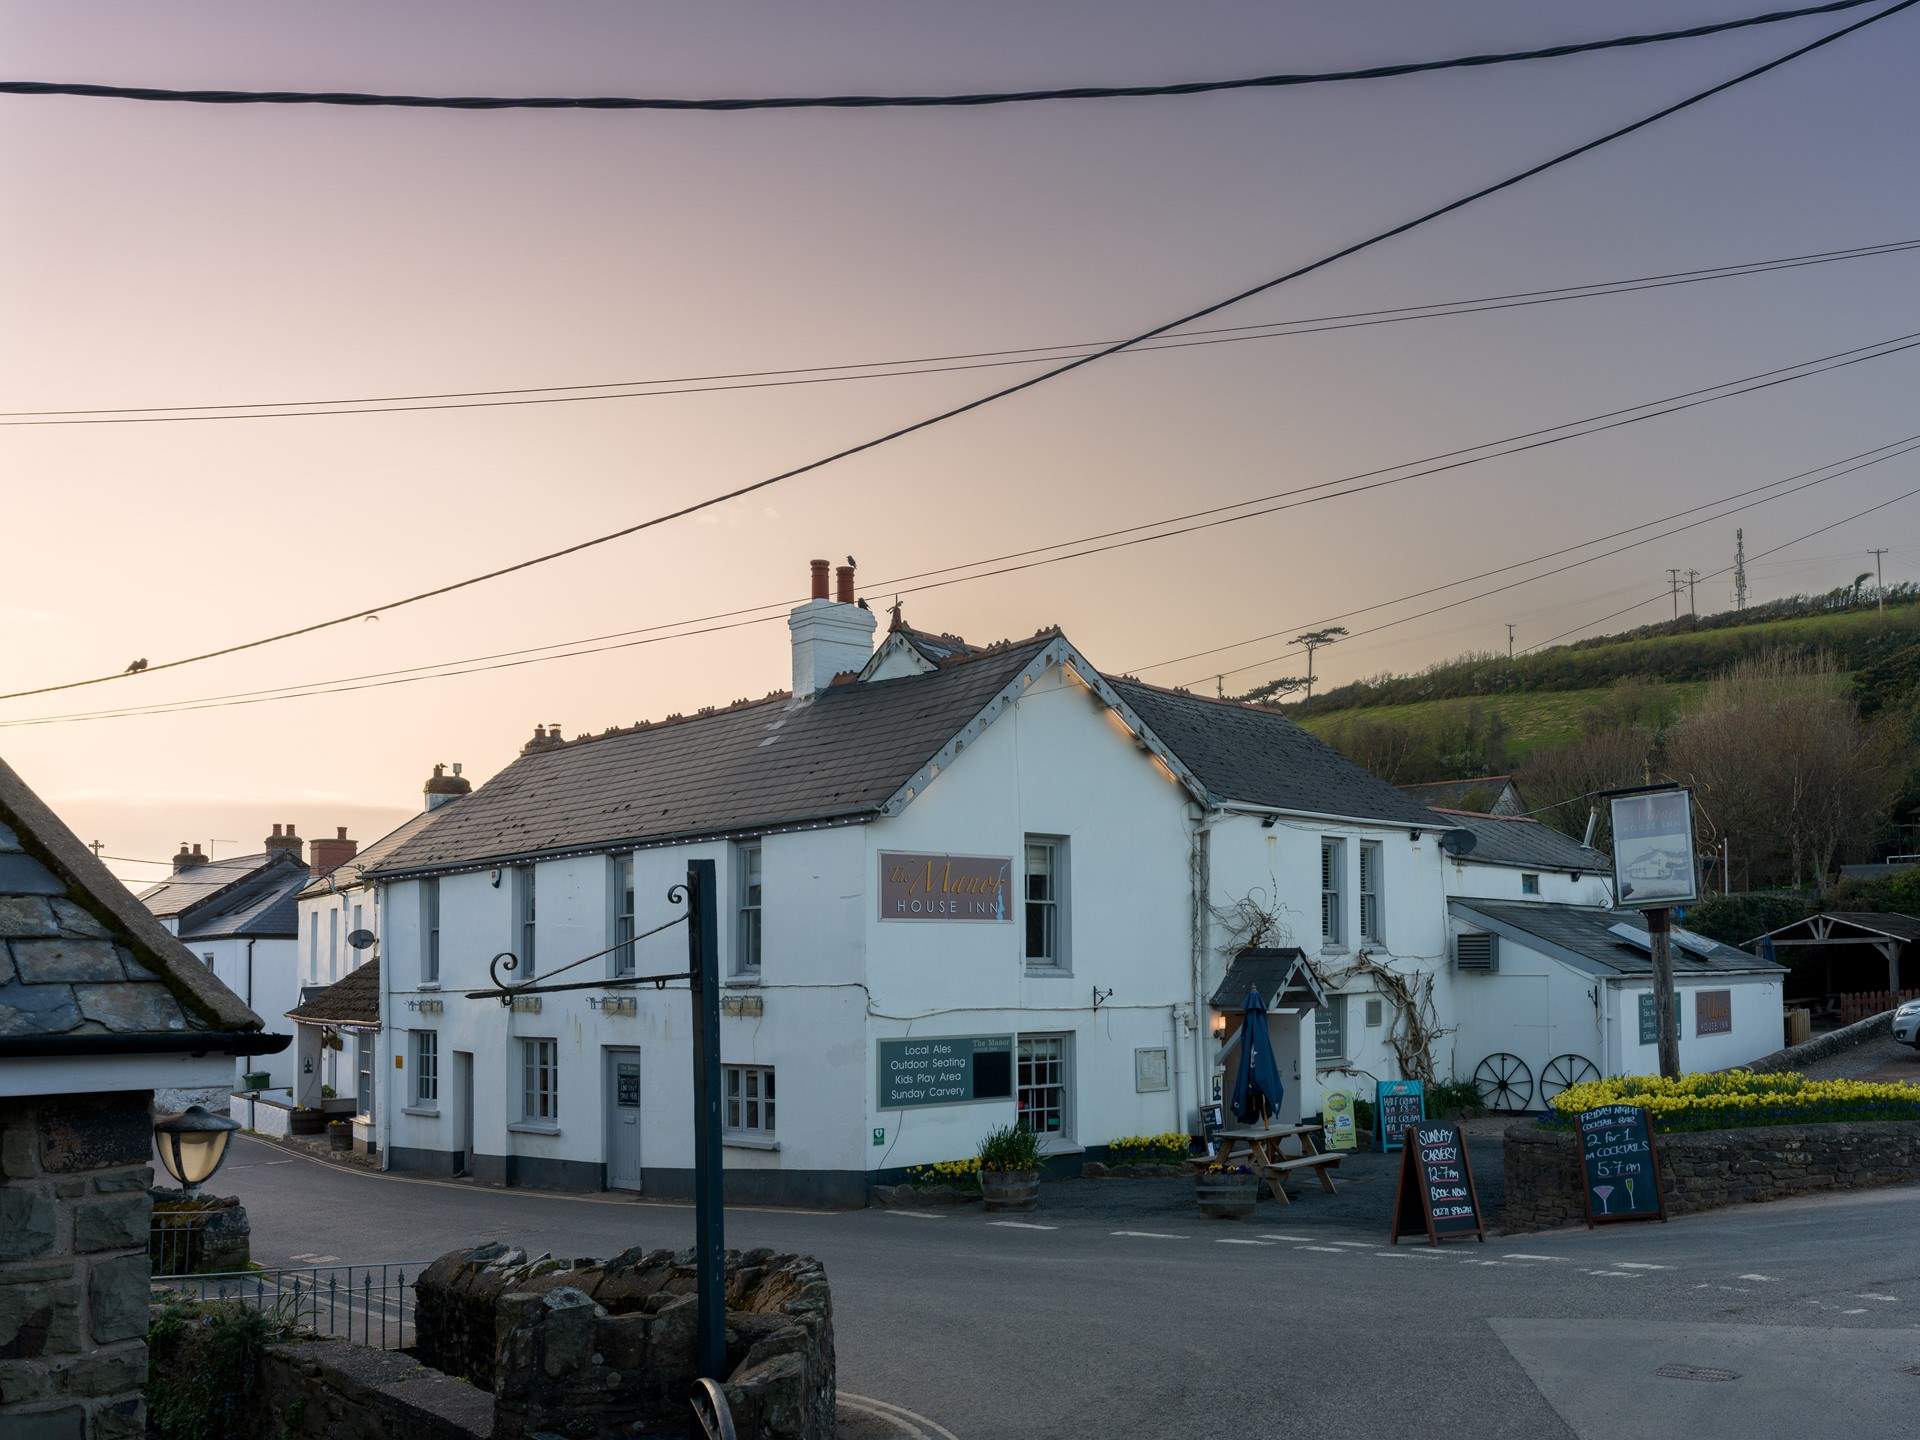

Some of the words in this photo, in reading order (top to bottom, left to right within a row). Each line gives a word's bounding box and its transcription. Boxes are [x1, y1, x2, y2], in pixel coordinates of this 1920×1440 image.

[906, 860, 1008, 896] Manor
[897, 900, 957, 913] HOUSE
[969, 901, 998, 913] INN
[905, 1045, 929, 1056] Local
[933, 1045, 952, 1054] Ales
[890, 1060, 928, 1070] Outdoor
[932, 1058, 966, 1068] Seating
[895, 1074, 913, 1084] Kids
[917, 1073, 936, 1084] Play
[939, 1072, 961, 1082] Area
[891, 1089, 926, 1100] Sunday
[929, 1087, 965, 1097] Carvery
[1581, 1106, 1611, 1123] FRIDAY
[1614, 1106, 1639, 1116] NIGHT
[1582, 1120, 1616, 1131] COCKTAIL
[1419, 1129, 1452, 1146] SUNDAY
[1587, 1134, 1601, 1147] 2
[1623, 1128, 1636, 1141] 1
[1422, 1147, 1456, 1162] CARVERY
[1597, 1140, 1650, 1157] COCKTAILS
[1430, 1186, 1450, 1200] BOOK
[1452, 1187, 1467, 1197] NOW
